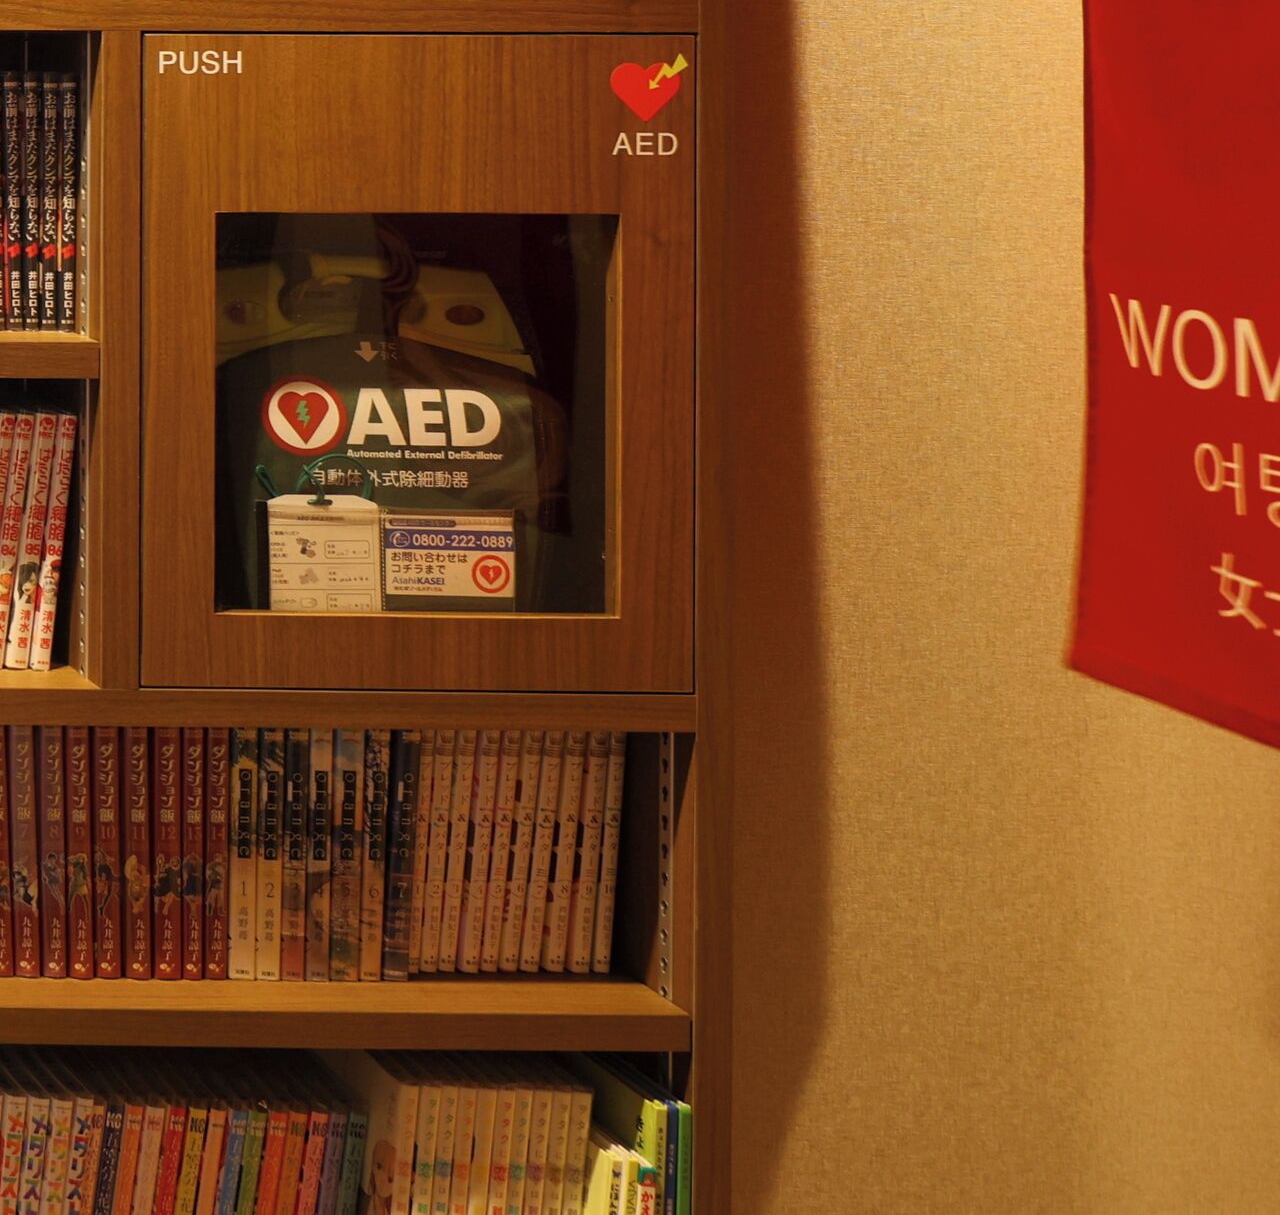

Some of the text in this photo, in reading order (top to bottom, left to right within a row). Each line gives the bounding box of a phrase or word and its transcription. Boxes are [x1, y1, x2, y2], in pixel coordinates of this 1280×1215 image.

[158, 51, 243, 74] PUSH
[612, 133, 678, 156] AED
[28, 271, 37, 317] 井田ヒロト
[63, 272, 73, 317] 井田ヒロト
[347, 388, 501, 446] AED
[347, 449, 503, 460] Automated External Defibrillator
[1, 543, 16, 555] 04
[412, 533, 513, 547] 0800-222-0889
[391, 552, 467, 563] お問い合わせは
[392, 564, 445, 575] コチラまで
[1211, 553, 1280, 636] 女
[266, 883, 274, 898] 2
